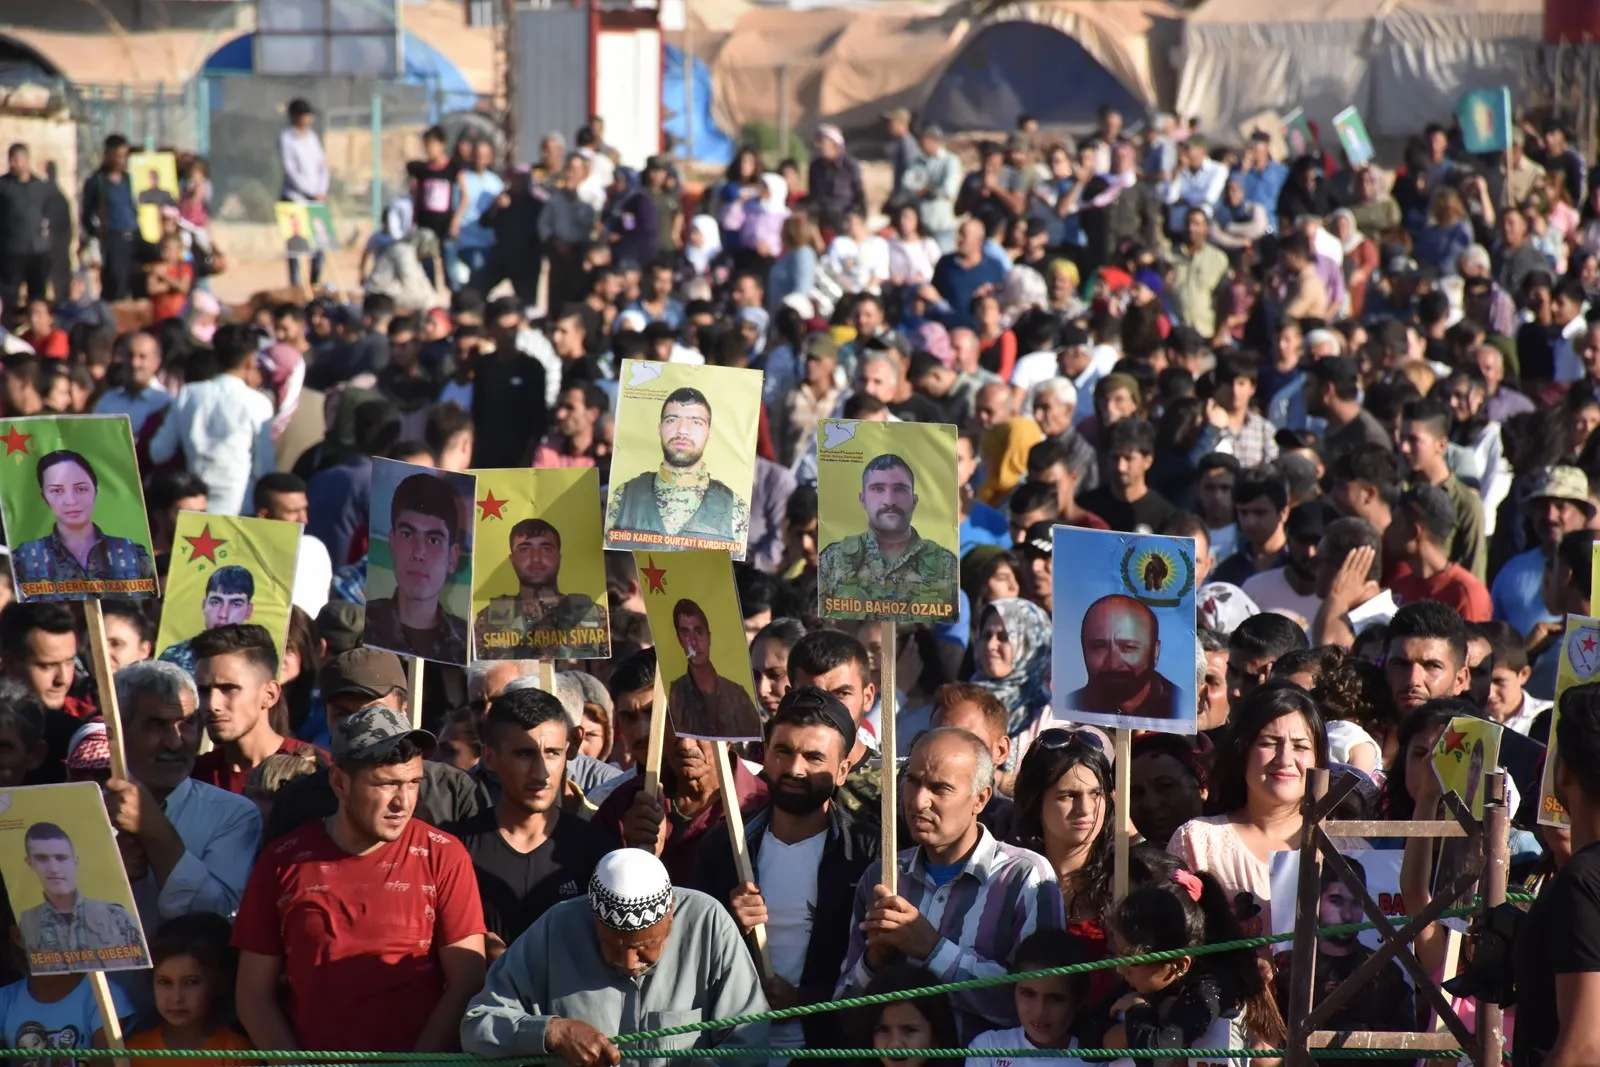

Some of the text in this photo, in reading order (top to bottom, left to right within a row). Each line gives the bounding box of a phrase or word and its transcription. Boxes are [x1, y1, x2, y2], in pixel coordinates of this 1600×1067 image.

[633, 532, 663, 545] KARKER
[865, 600, 907, 615] BAHOZ
[911, 603, 953, 617] OZALP
